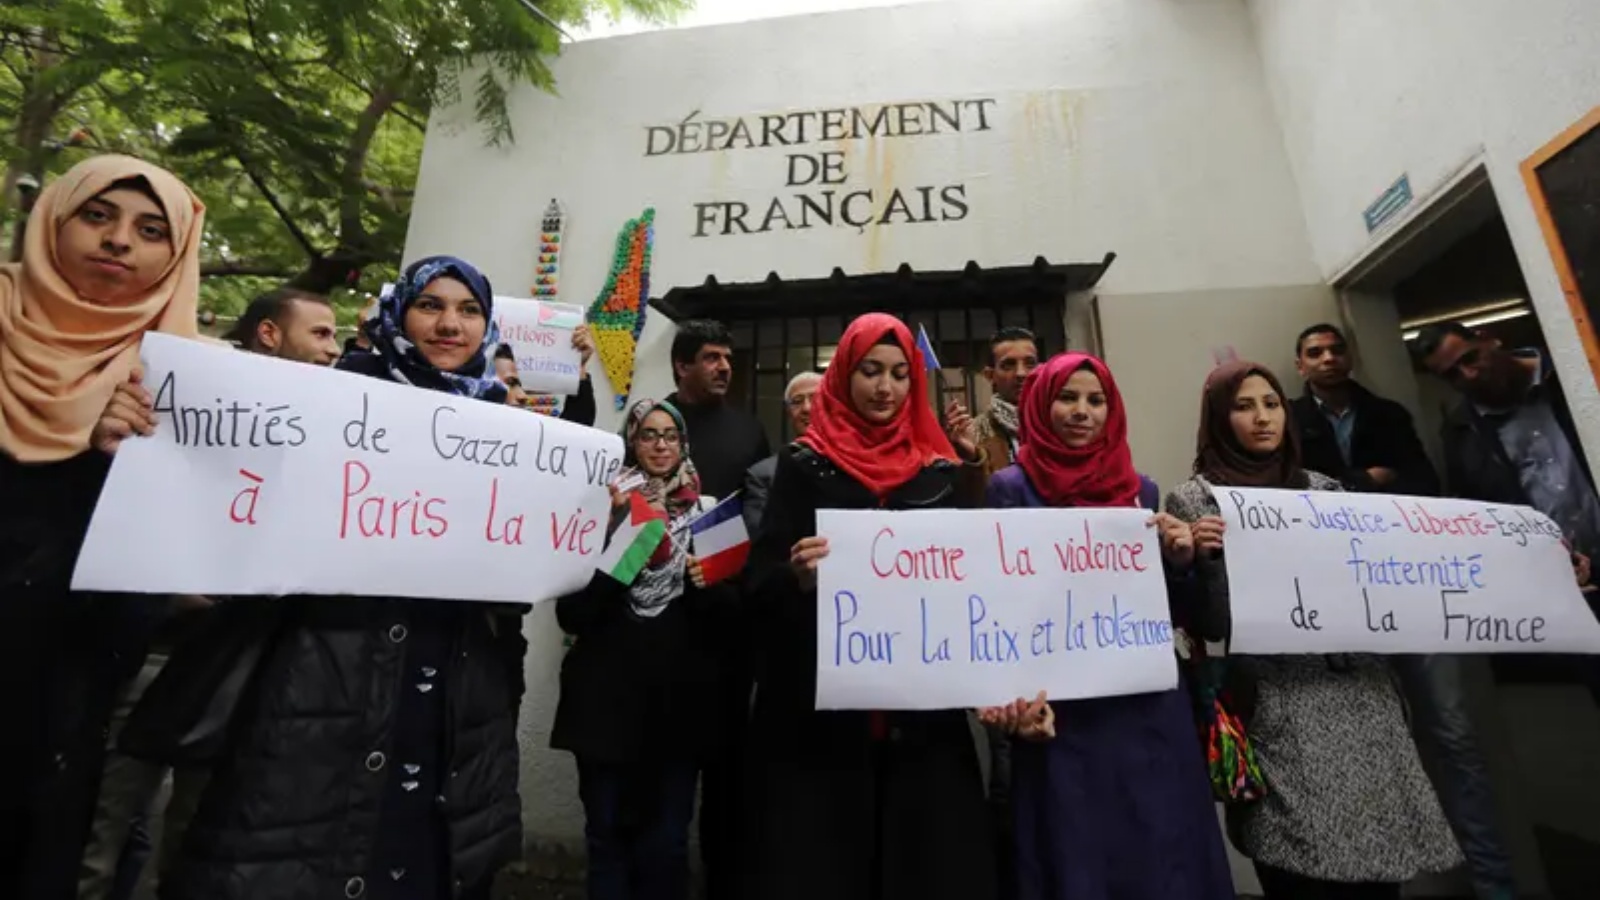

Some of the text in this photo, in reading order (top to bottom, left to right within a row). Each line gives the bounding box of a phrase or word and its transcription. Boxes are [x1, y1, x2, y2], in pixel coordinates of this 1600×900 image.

[644, 98, 995, 156] DÉPARTEMENT
[785, 151, 848, 187] DE
[691, 184, 969, 235] FRANÇAIS
[153, 370, 620, 487] Amitiés de Gaza la vie
[229, 460, 597, 555] à Paris la vie
[871, 527, 966, 581] Contre
[996, 521, 1036, 576] la
[1346, 537, 1486, 589] fraternité
[834, 589, 901, 667] Pour
[920, 597, 951, 664] la
[968, 594, 1020, 664] Paix
[1030, 616, 1055, 655] et
[1065, 589, 1088, 651] la
[1290, 577, 1546, 643] de la France
